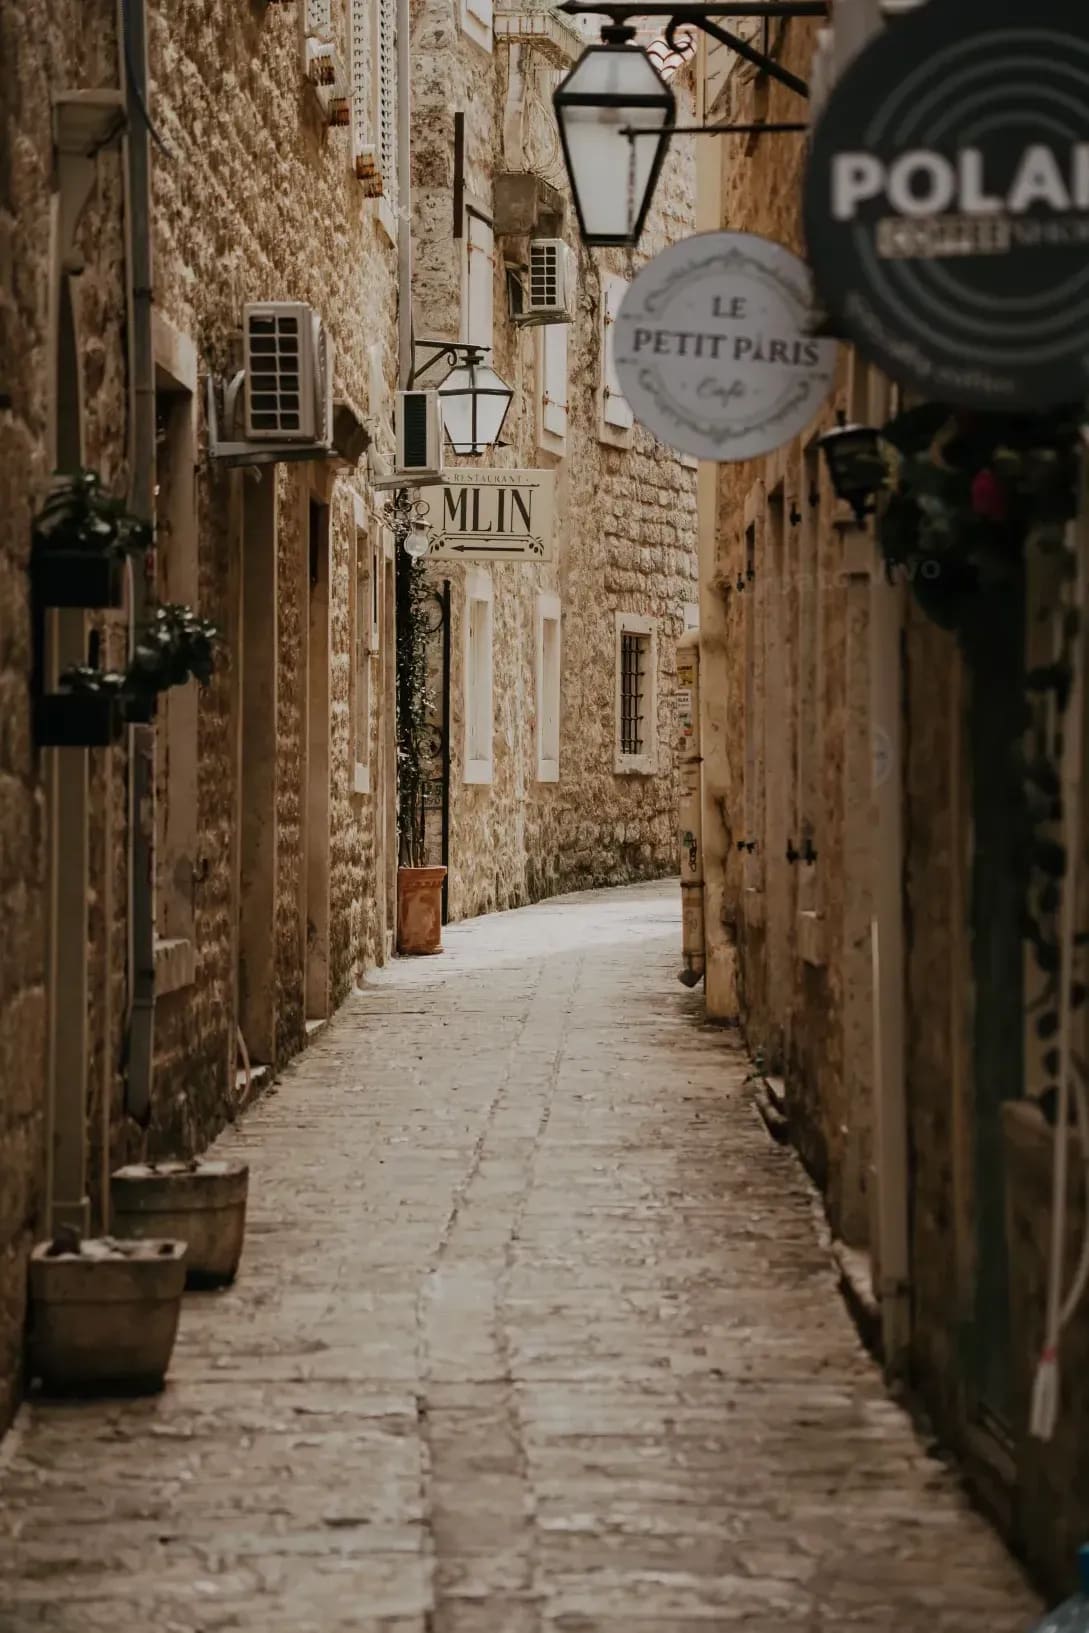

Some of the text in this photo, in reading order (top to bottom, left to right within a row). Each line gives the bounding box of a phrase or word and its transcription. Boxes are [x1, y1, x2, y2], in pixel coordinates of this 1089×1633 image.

[830, 142, 1089, 221] POLA
[712, 295, 747, 319] LE
[632, 328, 820, 367] PETIT PARIS
[453, 473, 522, 483] RESTAURANT
[442, 487, 534, 533] MLIN
